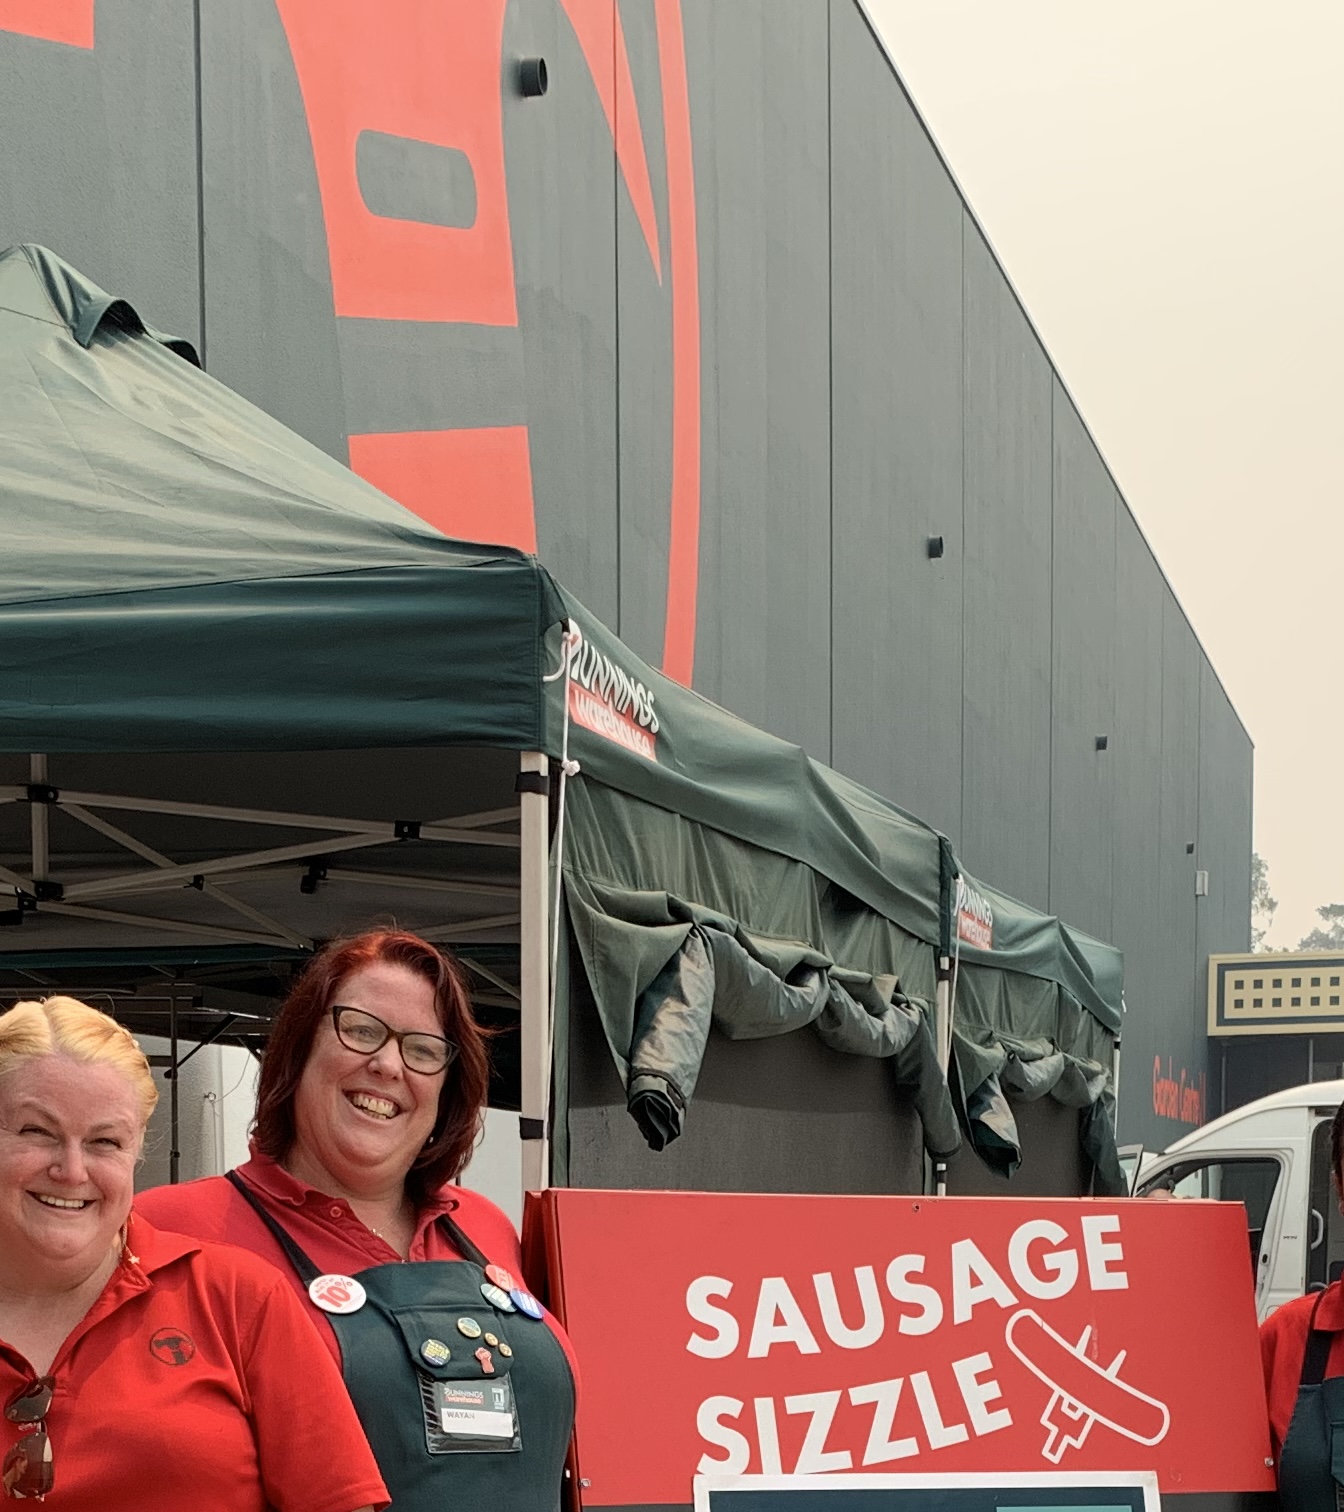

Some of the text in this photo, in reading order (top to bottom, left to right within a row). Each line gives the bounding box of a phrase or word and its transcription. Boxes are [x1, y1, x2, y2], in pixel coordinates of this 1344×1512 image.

[686, 1214, 1129, 1359] SAUSAGE
[444, 1387, 484, 1399] BUNNINGS
[696, 1351, 1013, 1475] SIZZLE
